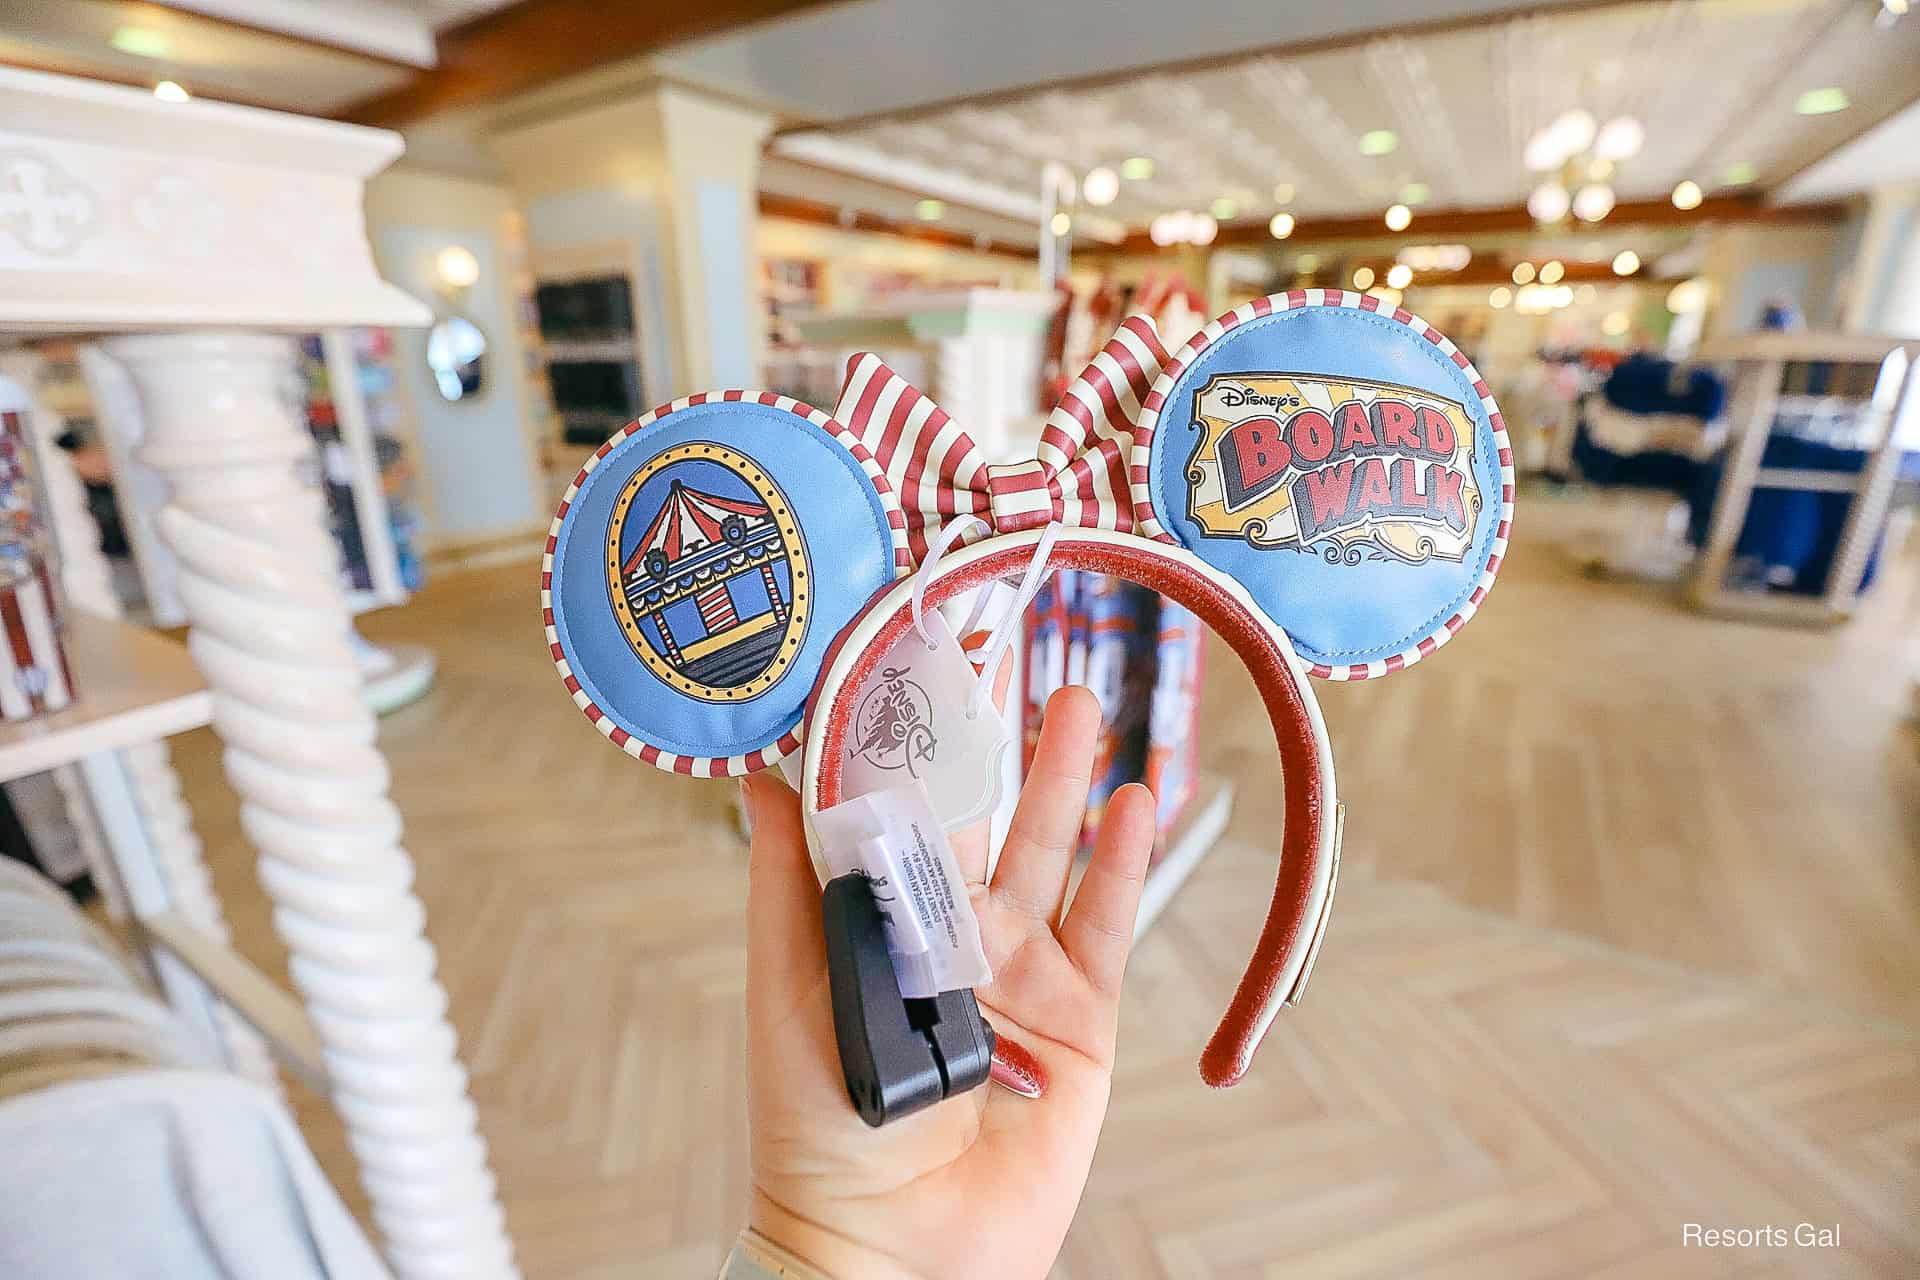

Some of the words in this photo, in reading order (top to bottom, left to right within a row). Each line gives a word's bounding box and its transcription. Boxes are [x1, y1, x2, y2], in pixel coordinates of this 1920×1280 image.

[1291, 458, 1467, 541] WALK
[883, 666, 938, 779] Disney
[902, 857, 917, 881] UNION
[915, 863, 932, 896] TRADING
[912, 880, 930, 921] EUROPEAN
[928, 897, 941, 923] DISNEY
[923, 921, 933, 929] IN
